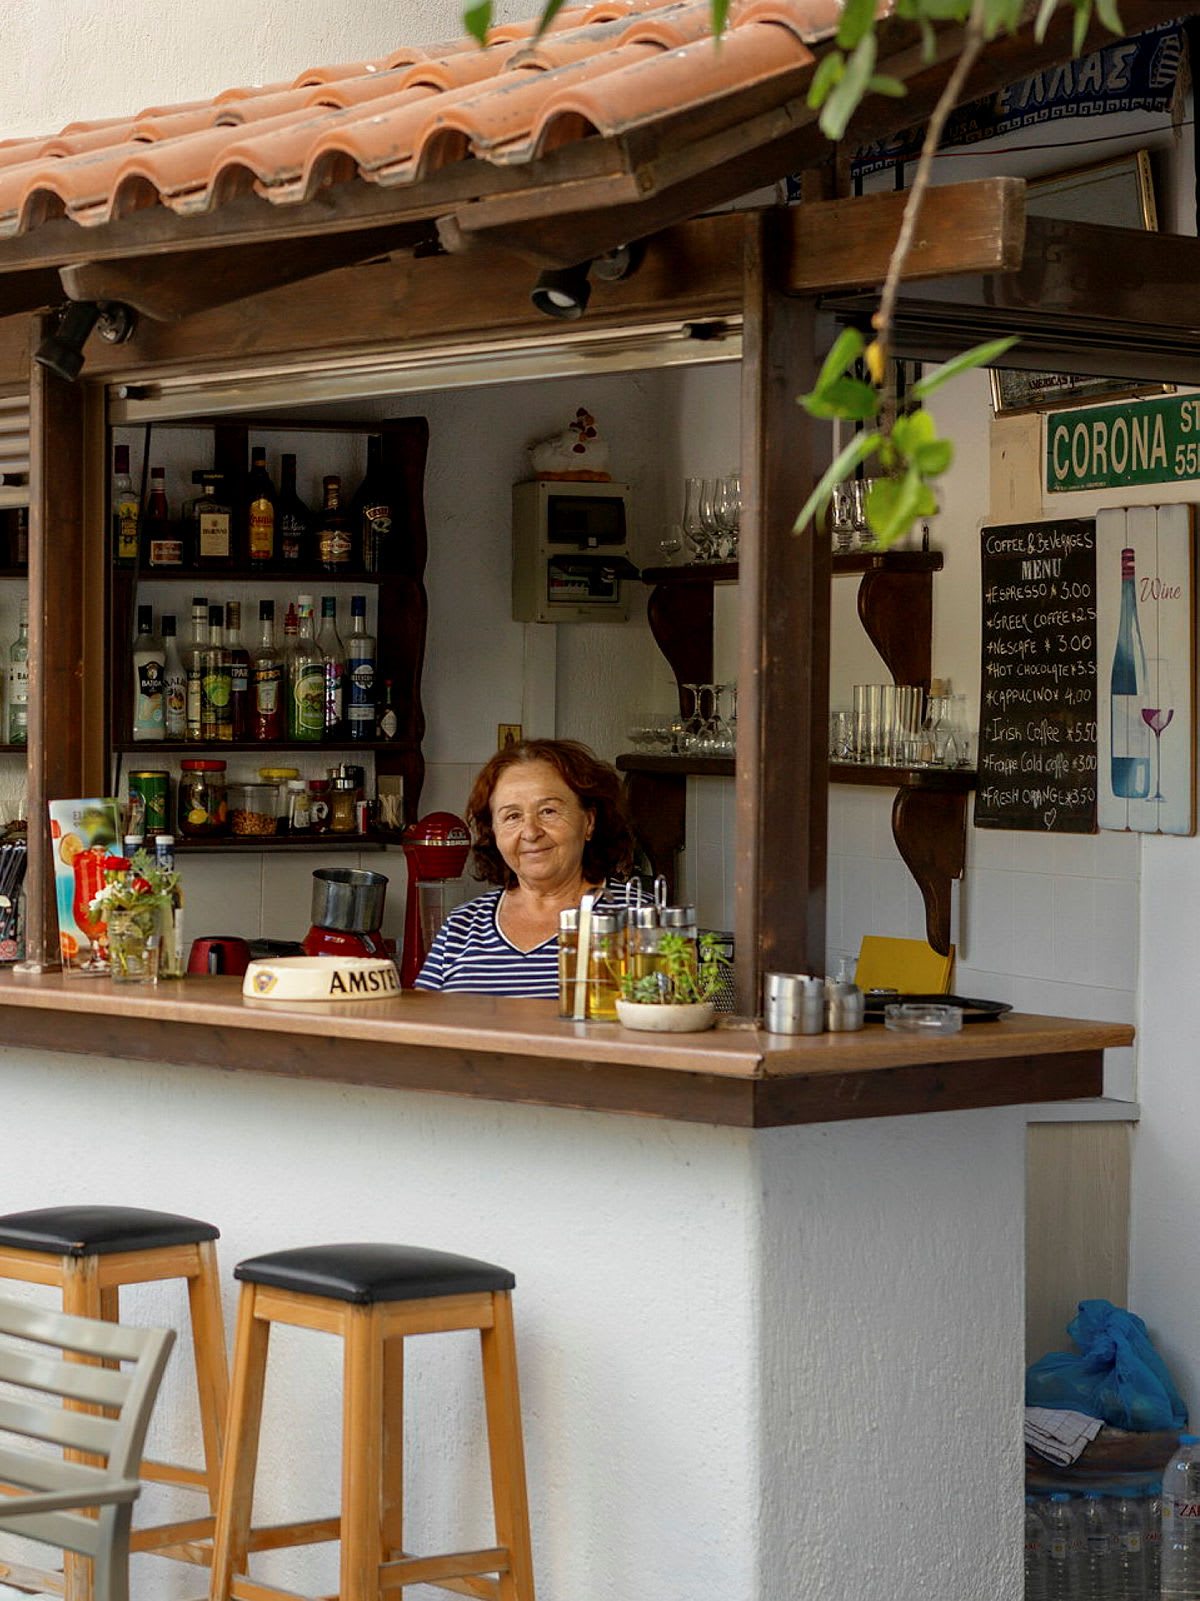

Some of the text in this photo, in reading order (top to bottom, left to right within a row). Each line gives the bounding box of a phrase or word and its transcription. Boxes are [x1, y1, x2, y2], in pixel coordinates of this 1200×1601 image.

[1053, 413, 1168, 481] CORONA
[1174, 443, 1200, 476] 55
[986, 535, 1026, 554] COFFEE
[1021, 558, 1062, 581] MENU
[1140, 576, 1182, 604] Wine
[993, 611, 1033, 633] GREEK
[993, 637, 1037, 660] NESCAFE
[994, 662, 1013, 678] HOT
[1016, 662, 1070, 684] CHOCOLATE
[991, 717, 1022, 742] Irish
[1026, 718, 1060, 746] Coffee
[1020, 751, 1043, 774] Cold
[986, 786, 1020, 808] FRESH
